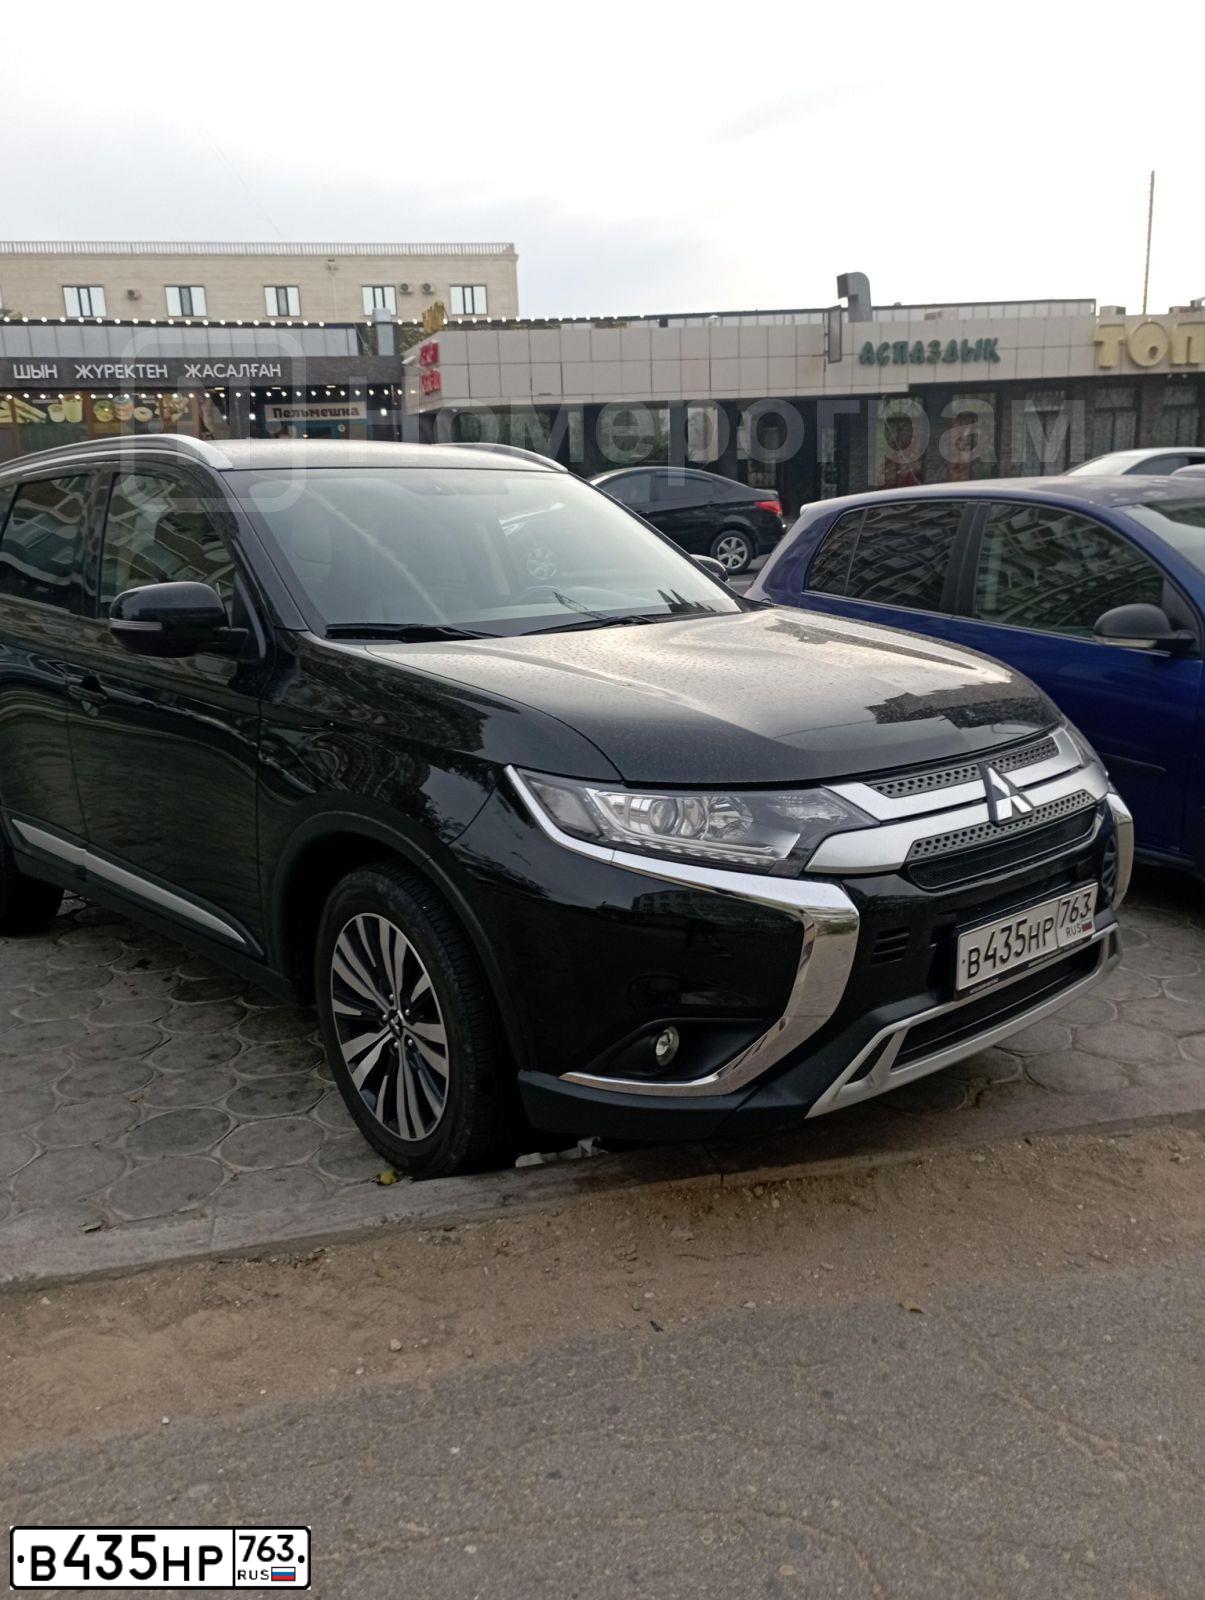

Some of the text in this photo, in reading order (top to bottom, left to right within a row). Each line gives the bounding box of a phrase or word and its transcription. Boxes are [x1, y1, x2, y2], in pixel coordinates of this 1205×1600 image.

[13, 364, 58, 379] ШЫН
[184, 363, 282, 379] ЖАСАЛҒАН
[272, 407, 360, 418] Пельмешка
[1060, 892, 1092, 928] 763
[1066, 925, 1082, 938] RUS
